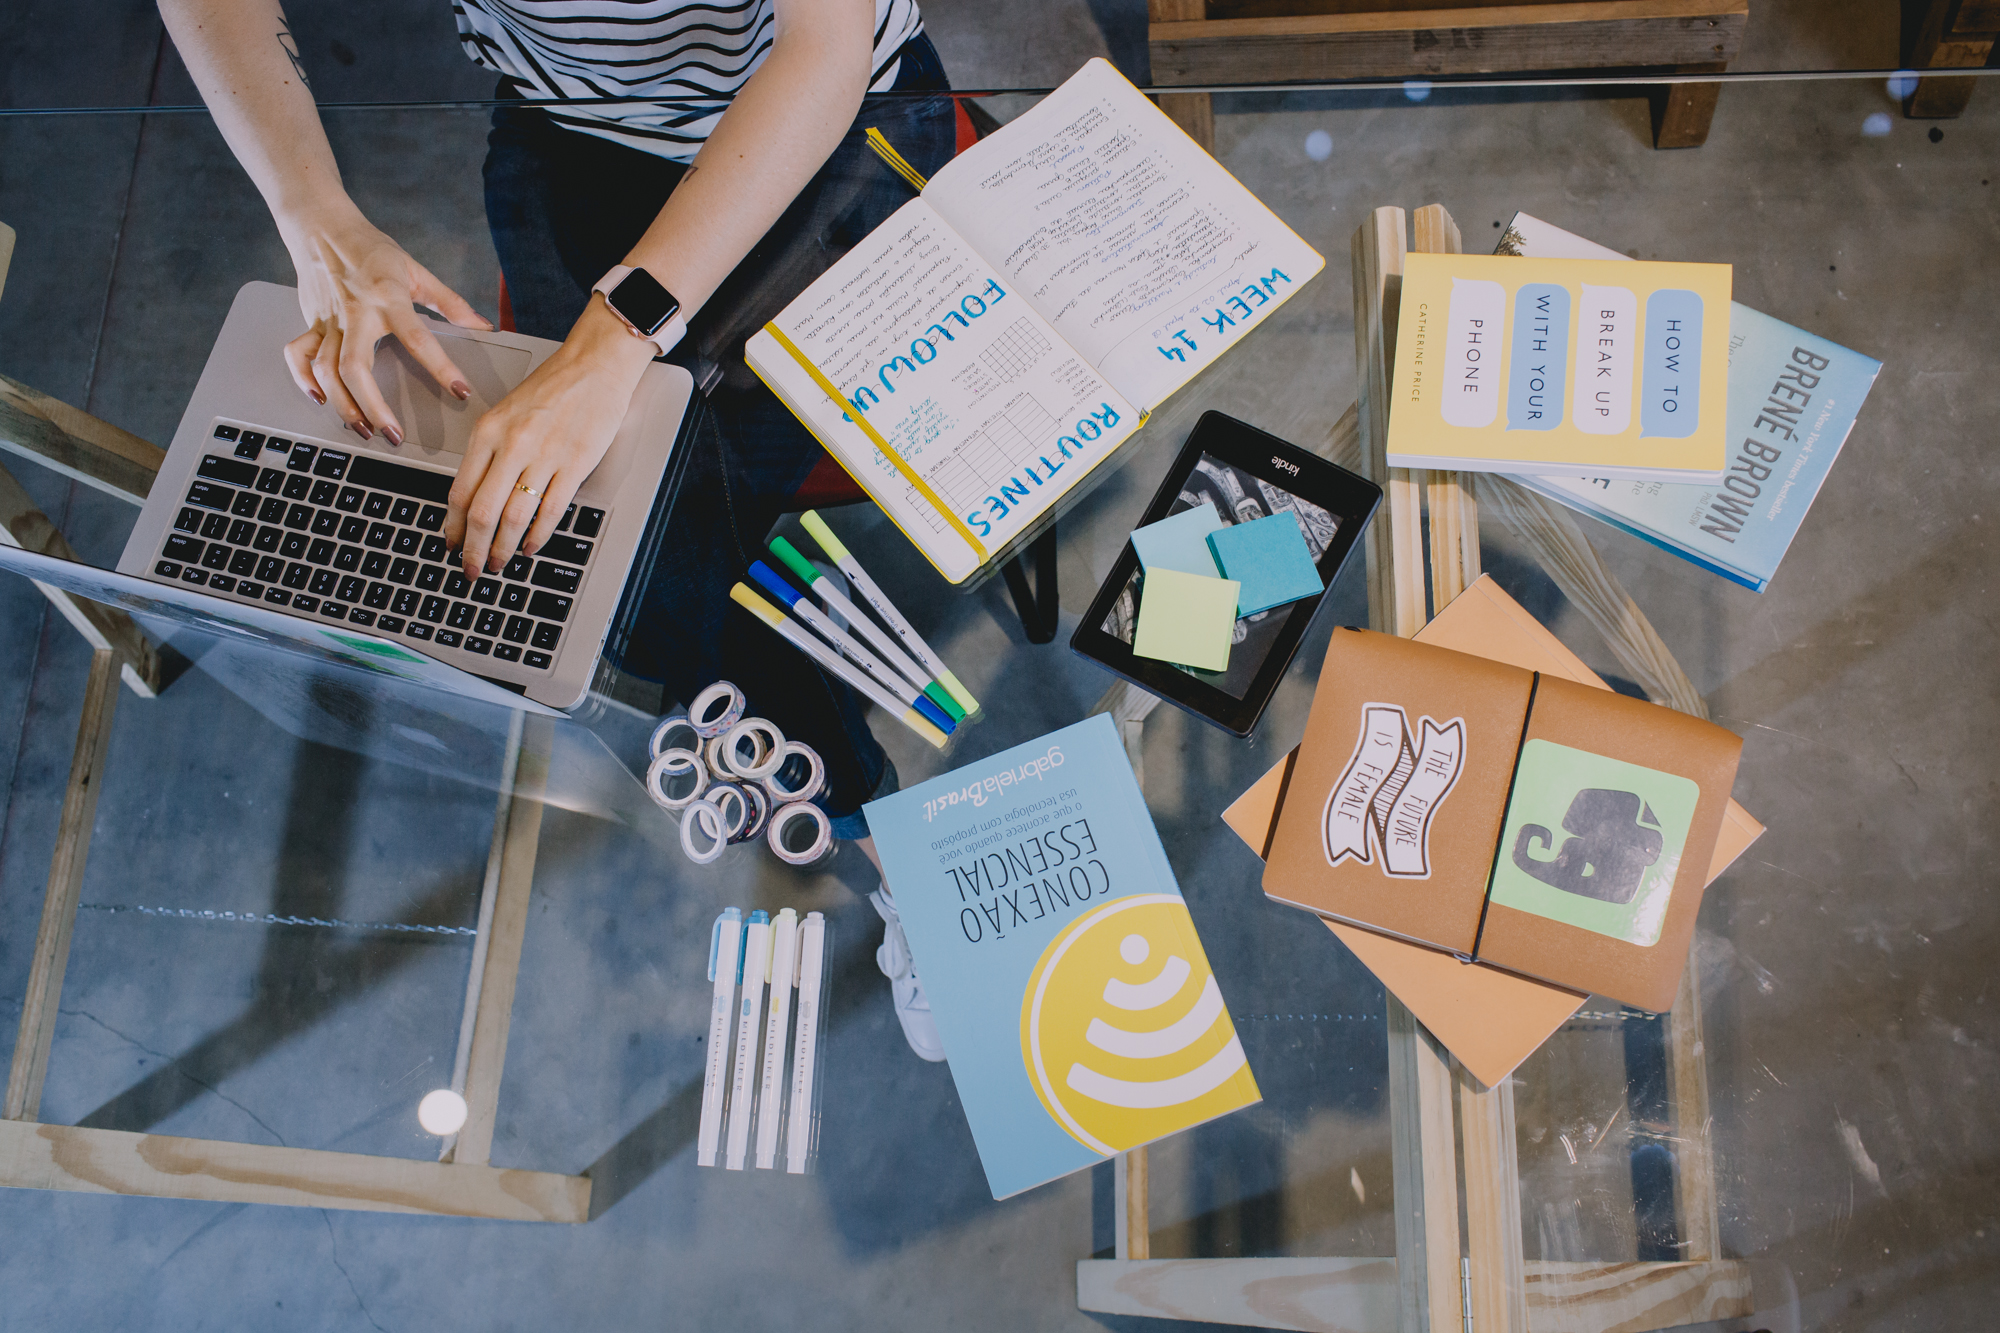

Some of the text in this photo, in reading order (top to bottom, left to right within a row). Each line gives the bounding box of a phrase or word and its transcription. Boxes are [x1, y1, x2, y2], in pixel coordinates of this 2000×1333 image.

[1216, 272, 1243, 295] April
[1200, 294, 1215, 305] 02
[1156, 267, 1292, 362] WEEK 14
[877, 277, 1006, 393] FOLLOW
[1410, 302, 1428, 402] CATHERINE PRICE
[1463, 318, 1483, 392] PHONE
[1526, 294, 1550, 420] WITH YOUR
[1594, 309, 1615, 417] BREAK UP
[1661, 319, 1681, 413] HOW TO
[966, 380, 1001, 410] MEDITATION
[1003, 391, 1027, 409] MONDAY
[1813, 409, 1831, 431] New
[1698, 345, 1830, 544] BRENÉ BROWN
[1801, 431, 1820, 453] York
[321, 450, 346, 460] command
[966, 402, 1121, 537] ROUTINES
[1270, 455, 1300, 477] kindle
[1787, 453, 1808, 482] Times
[345, 494, 355, 503] M
[1765, 479, 1796, 521] bestseller
[371, 500, 381, 509] N
[296, 511, 302, 520] L
[400, 507, 407, 516] B
[1687, 505, 1705, 527] LMSW
[321, 518, 329, 526] K
[426, 513, 434, 522] V
[348, 524, 356, 533] J
[263, 534, 271, 543] P
[374, 530, 383, 539] H
[171, 536, 187, 545] delete
[289, 540, 298, 549] O
[402, 537, 410, 546] G
[429, 544, 437, 552] F
[574, 542, 587, 550] shift
[318, 547, 323, 555] I
[343, 553, 352, 562] U
[267, 560, 274, 568] 0
[370, 560, 377, 569] Y
[514, 562, 522, 571] A
[294, 567, 300, 575] 9
[398, 566, 405, 575] T
[553, 567, 577, 577] caps lock
[321, 573, 328, 581] 8
[426, 572, 434, 582] R
[348, 580, 355, 588] 7
[454, 579, 461, 588] E
[376, 586, 383, 594] 6
[479, 586, 490, 595] W
[403, 593, 410, 602] 5
[509, 592, 517, 601] Q
[431, 599, 438, 608] 4
[556, 598, 566, 606] tab
[459, 606, 466, 615] 3
[487, 612, 494, 621] 2
[516, 620, 521, 629] 1
[1337, 730, 1393, 824] IS FEMALE
[1393, 748, 1453, 848] THE FUTURE
[930, 787, 1077, 850] usa tecnologia com propósito
[938, 801, 1082, 865] o que acontece quando você
[944, 817, 1097, 902] ESSENCIAL
[959, 858, 1110, 943] CONEXÃO
[711, 1017, 724, 1088] MILDLINER
[736, 1021, 748, 1091] MILDLINER
[764, 1019, 776, 1090] MILDLINER
[797, 1023, 809, 1094] MILDLINER
